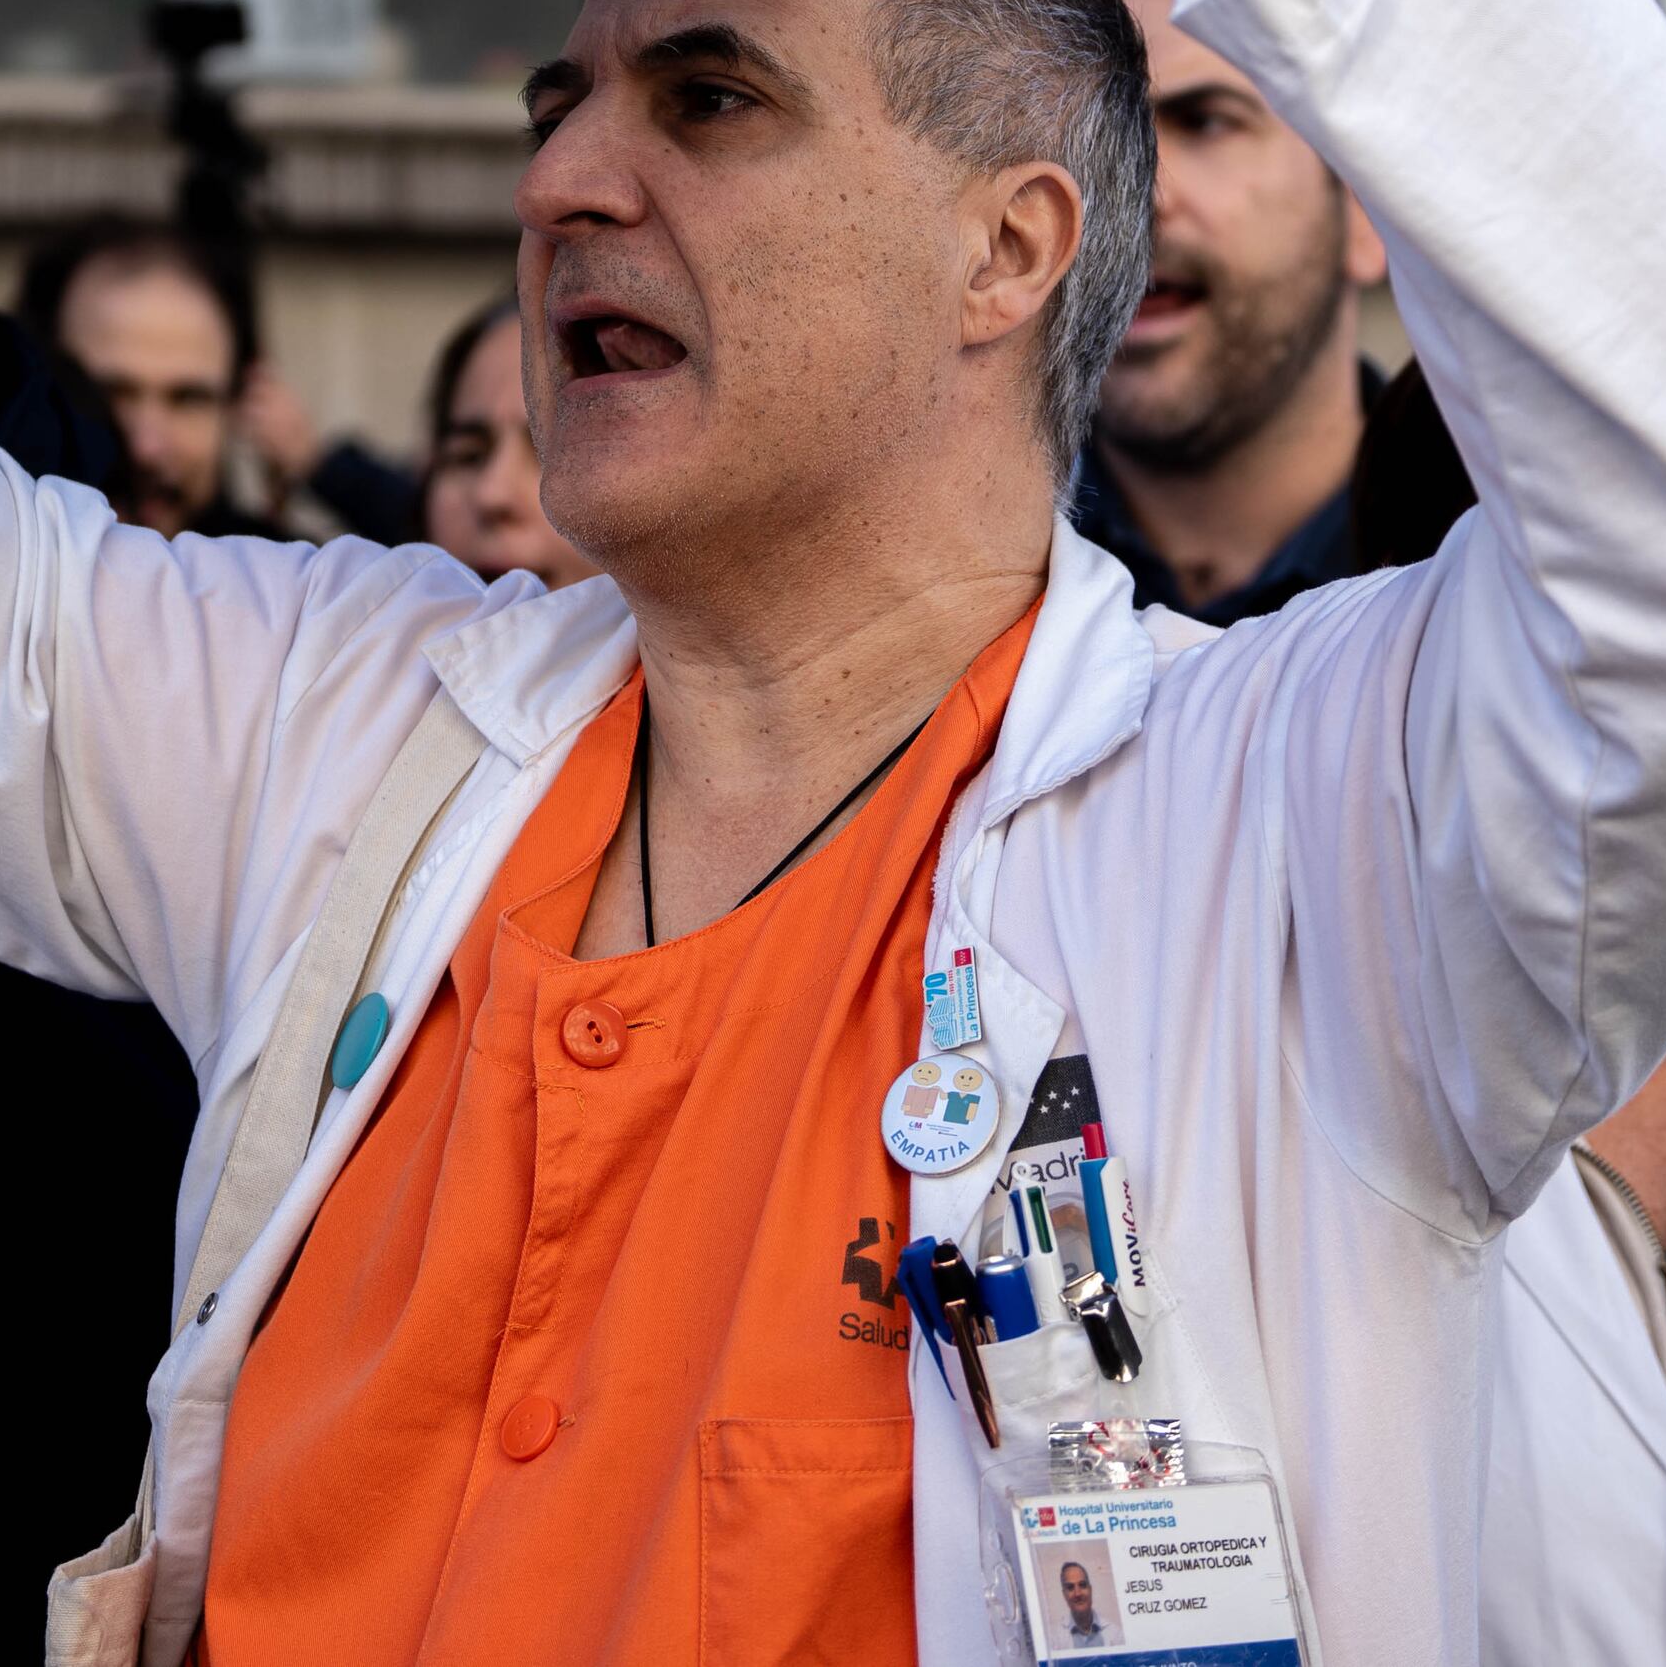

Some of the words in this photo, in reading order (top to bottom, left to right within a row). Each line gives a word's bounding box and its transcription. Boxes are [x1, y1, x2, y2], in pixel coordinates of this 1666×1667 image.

[924, 972, 948, 1003] 70
[964, 966, 978, 1020] Princesa
[968, 1024, 979, 1039] La
[890, 1129, 971, 1163] EMPATIA
[1058, 1503, 1104, 1517] Hospital
[1106, 1498, 1174, 1514] Universitario
[1061, 1519, 1081, 1535] de
[1085, 1517, 1105, 1534] La
[1109, 1515, 1177, 1532] Princesa
[1129, 1542, 1178, 1558] CIRUGIA
[1180, 1537, 1257, 1555] ORTOPEDICA
[1257, 1535, 1268, 1548] Y
[1151, 1555, 1253, 1573] TRAUMATOLOGIA
[1124, 1578, 1163, 1594] JESUS
[1128, 1599, 1162, 1615] CRUZ
[1163, 1596, 1208, 1613] GOMEZ
